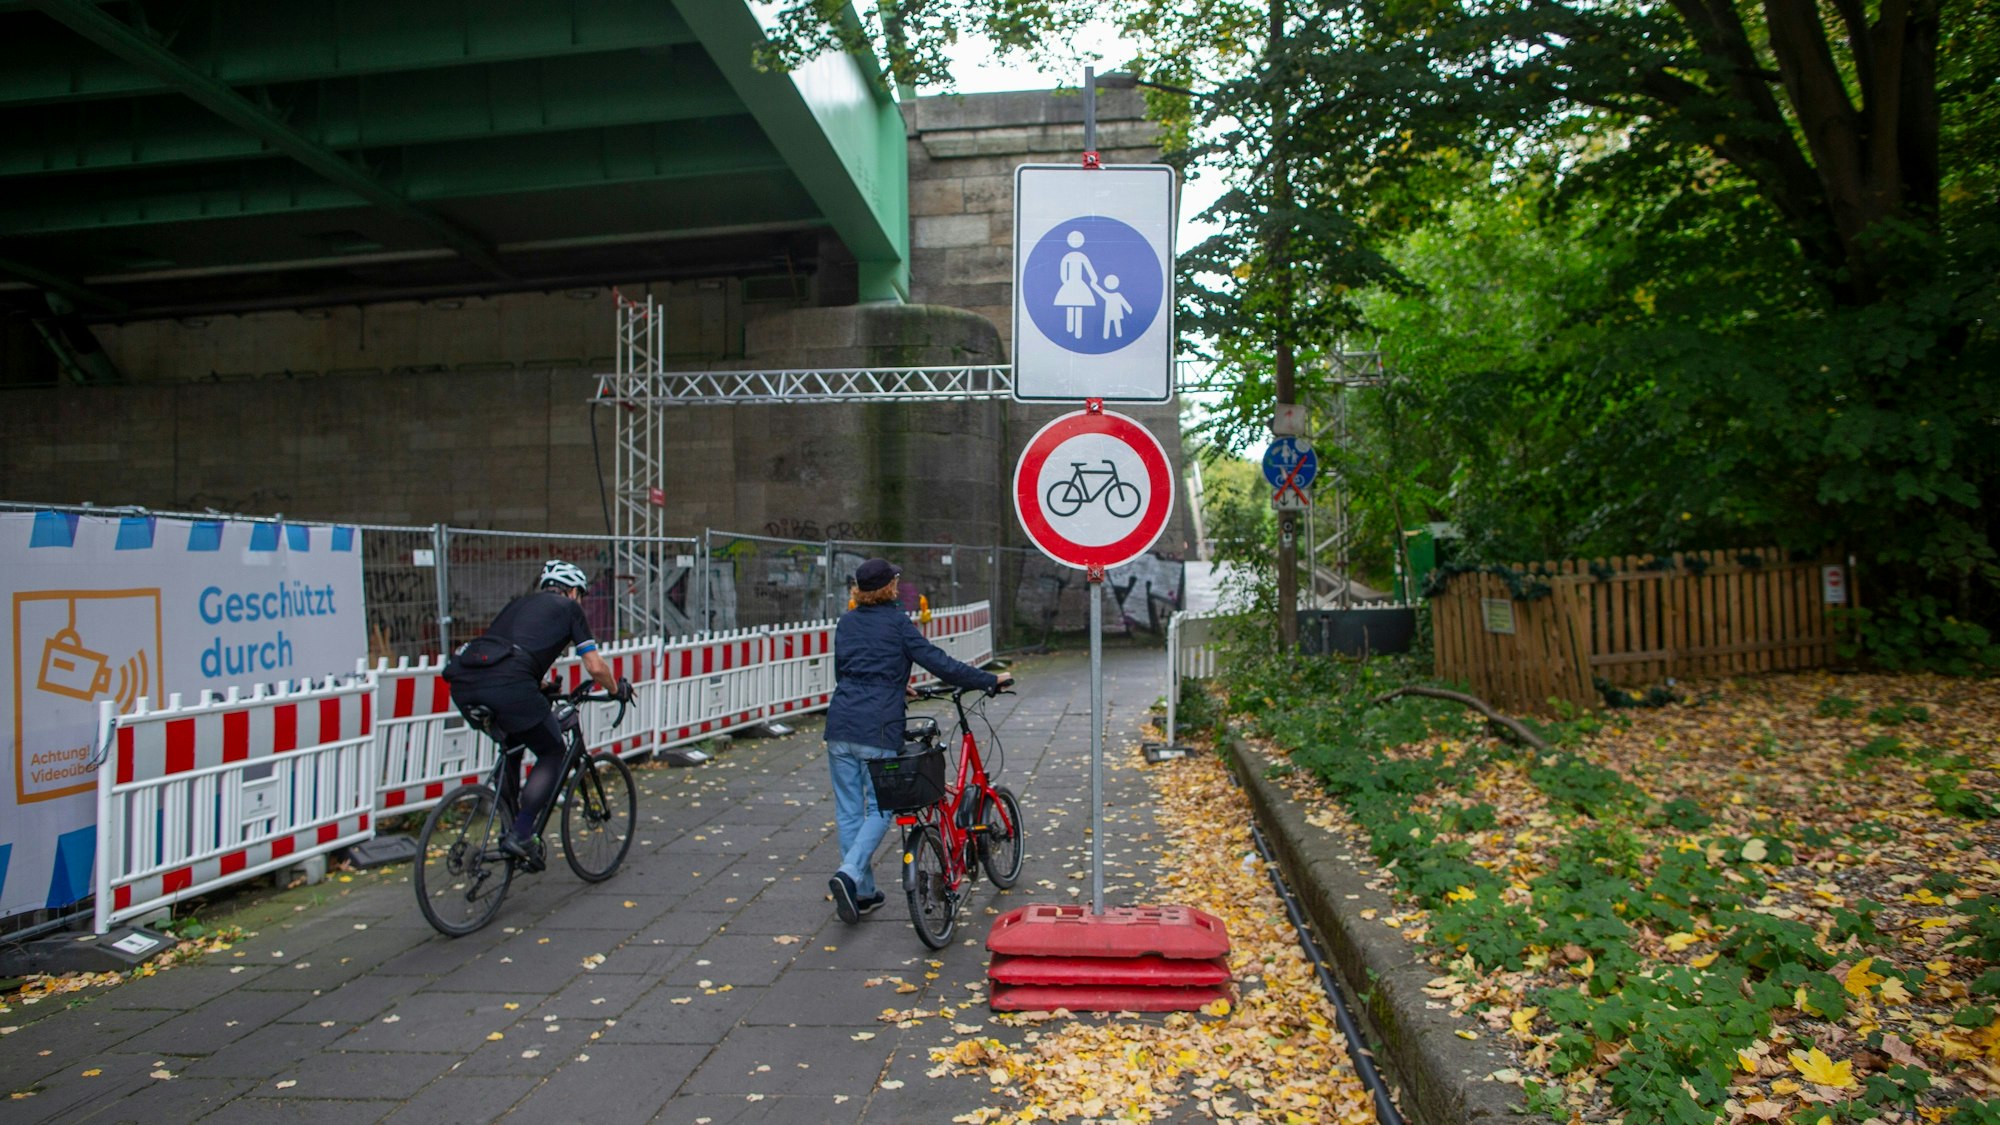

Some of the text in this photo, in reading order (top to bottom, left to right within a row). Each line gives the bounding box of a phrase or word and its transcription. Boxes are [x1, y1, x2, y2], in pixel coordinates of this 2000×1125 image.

[199, 580, 337, 625] Geschützt
[200, 630, 293, 678] durch
[31, 744, 91, 766] Achtung!
[31, 763, 98, 783] Videoübe
